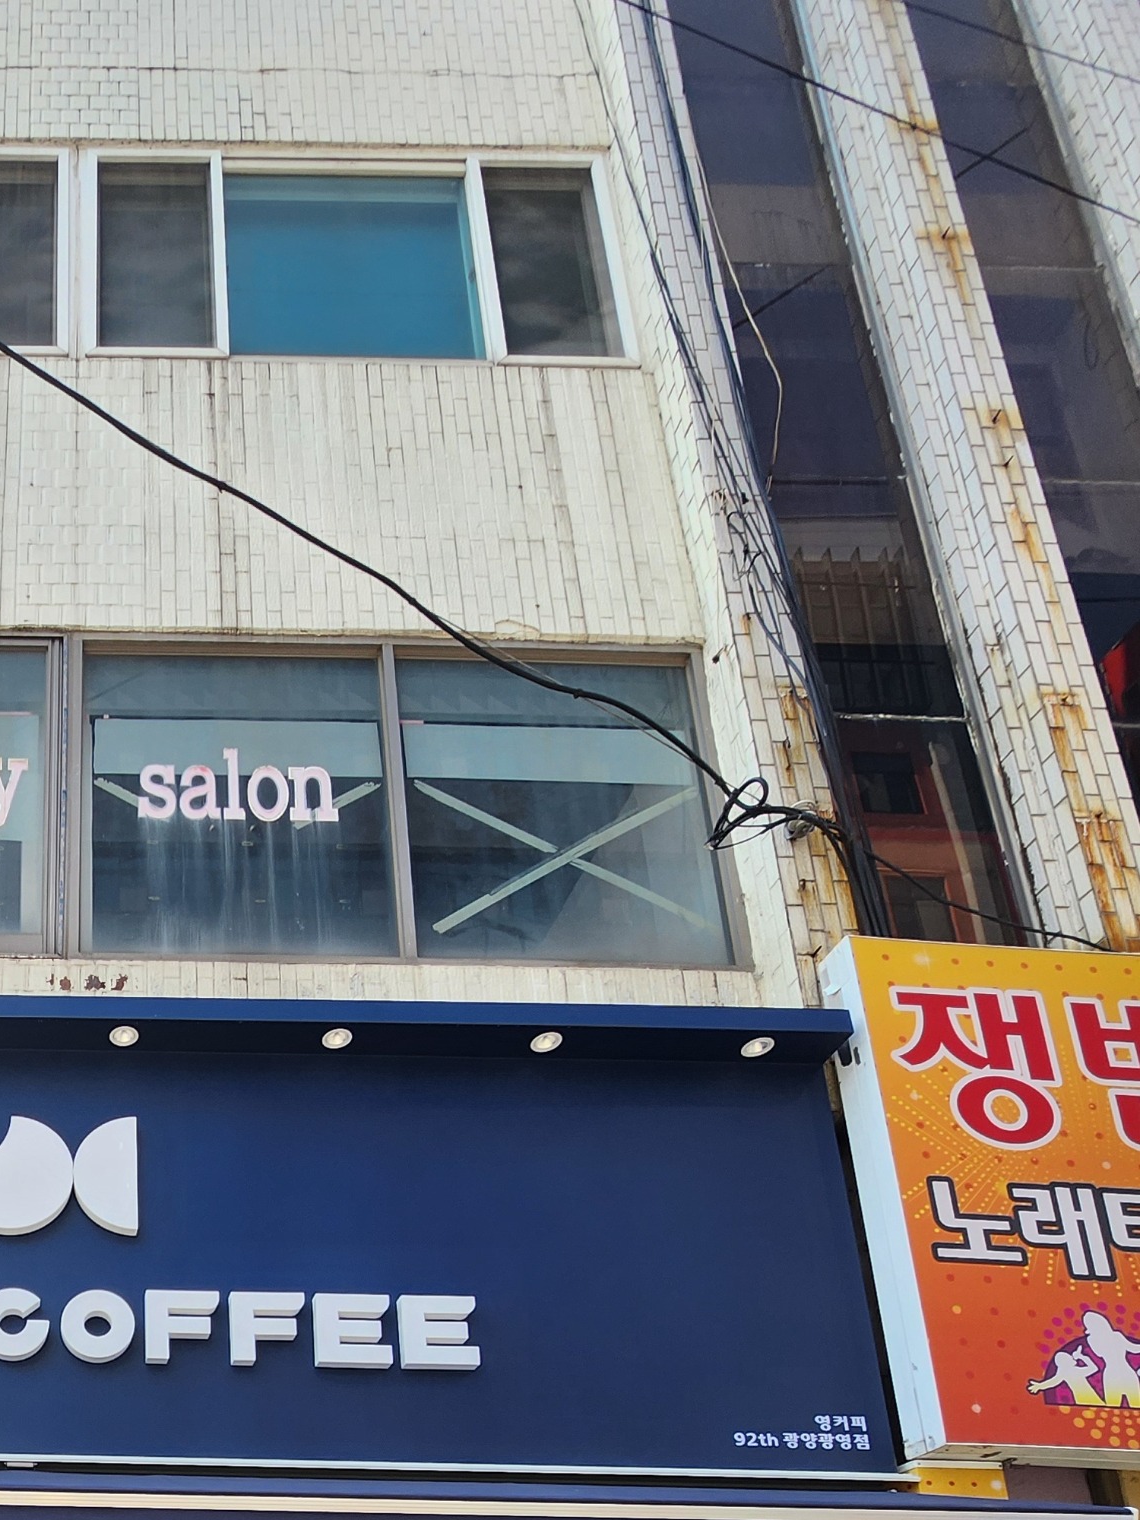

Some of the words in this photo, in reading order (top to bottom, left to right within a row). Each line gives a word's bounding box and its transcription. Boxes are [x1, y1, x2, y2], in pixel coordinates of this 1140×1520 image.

[138, 747, 340, 823] salon
[814, 1415, 868, 1432] 영커피
[733, 1432, 779, 1447] 92th
[782, 1431, 871, 1451] 광양광영점
